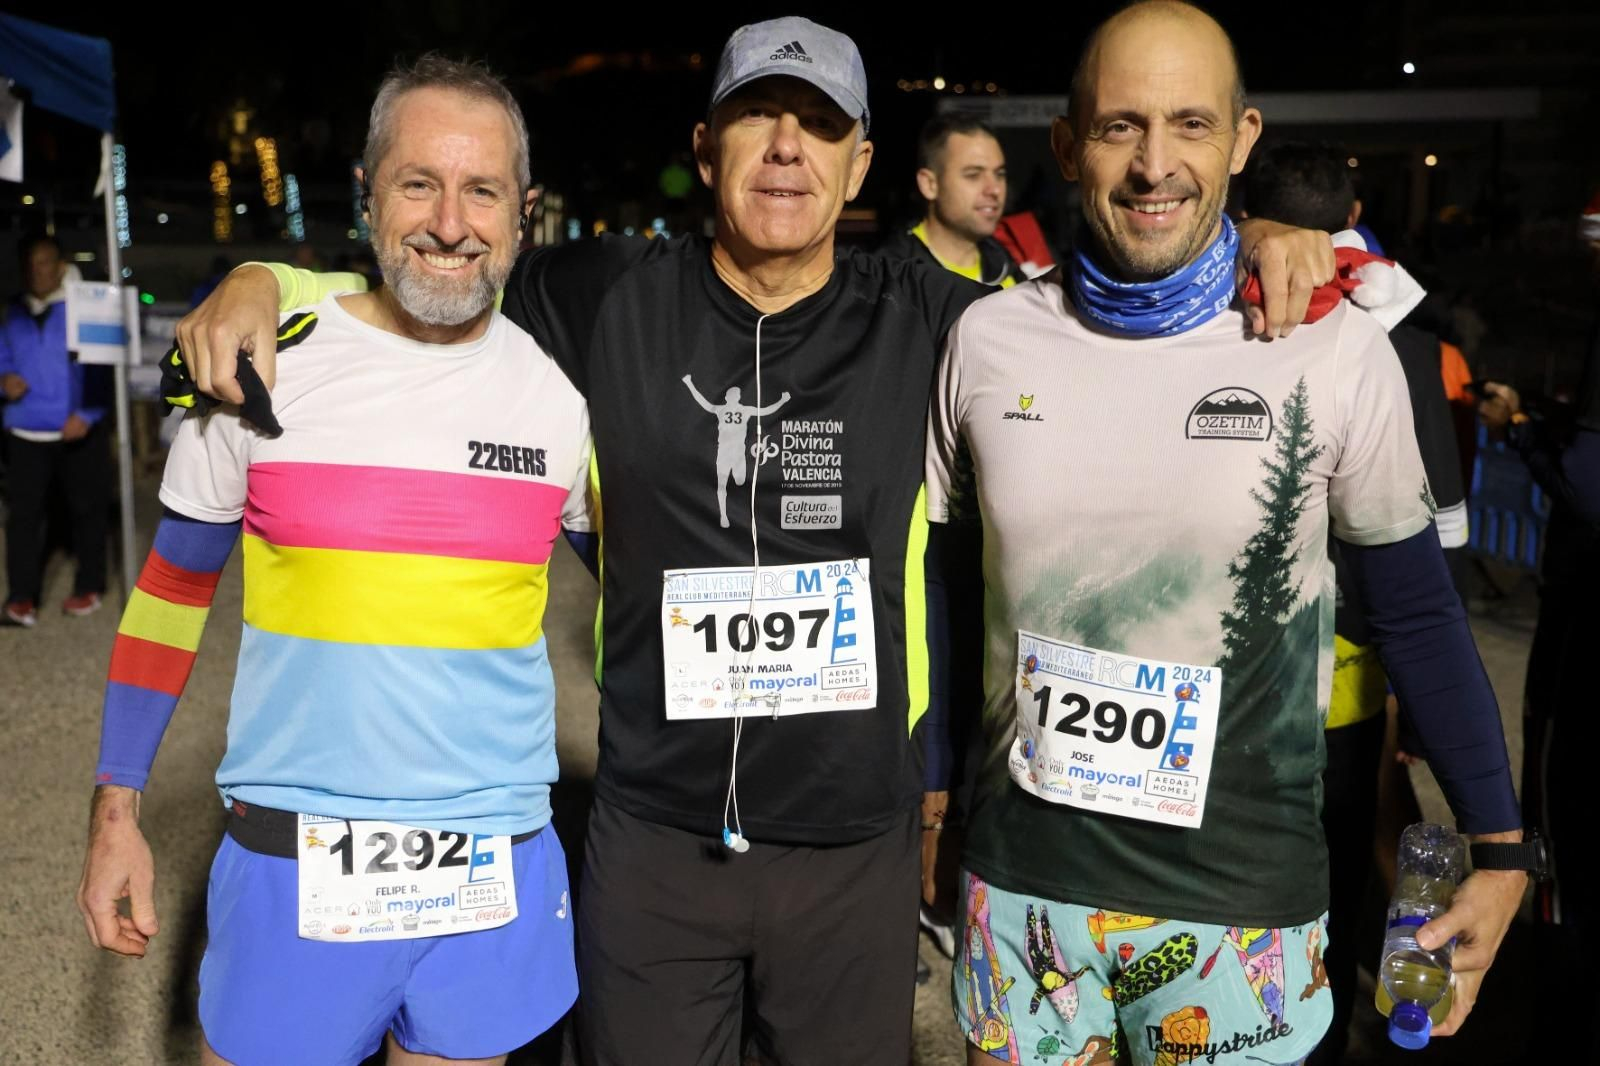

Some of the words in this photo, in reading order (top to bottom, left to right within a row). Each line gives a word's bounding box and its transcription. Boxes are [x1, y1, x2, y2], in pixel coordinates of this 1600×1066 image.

[769, 51, 813, 64] adidas
[724, 411, 743, 425] 33
[1002, 411, 1044, 421] SPALL
[1196, 416, 1264, 429] OZETIM
[781, 419, 843, 433] MARATÓN
[1232, 429, 1260, 437] SYSTEM
[782, 434, 833, 450] Divina
[467, 440, 547, 477] 226ERS
[781, 451, 842, 466] Pastora
[782, 468, 842, 481] VALENCIA
[786, 501, 827, 512] Cultura
[785, 512, 837, 524] Esfuerzo
[667, 578, 689, 592] SAN
[760, 569, 822, 597] RCM
[684, 592, 701, 600] CLUB
[693, 608, 830, 653] 1097
[1040, 643, 1096, 671] SILVESTRE
[728, 665, 753, 674] JUAN
[758, 663, 792, 673] MARIA
[829, 668, 860, 677] AEDAS
[1099, 655, 1166, 692] RCM
[749, 673, 817, 691] mayoral
[829, 676, 860, 685] HOMES
[1033, 685, 1167, 750] 1290
[1070, 750, 1095, 763] JOSE
[1049, 763, 1064, 774] YOU
[1068, 766, 1142, 788] mayoral
[1154, 776, 1190, 788] AEDAS
[1153, 784, 1188, 796] HOMES
[329, 829, 469, 876] 1292
[376, 885, 407, 896] FELIPE
[410, 884, 421, 894] R.
[466, 887, 499, 897] AEDAS
[386, 892, 455, 914] mayoral
[466, 894, 500, 904] HOMES
